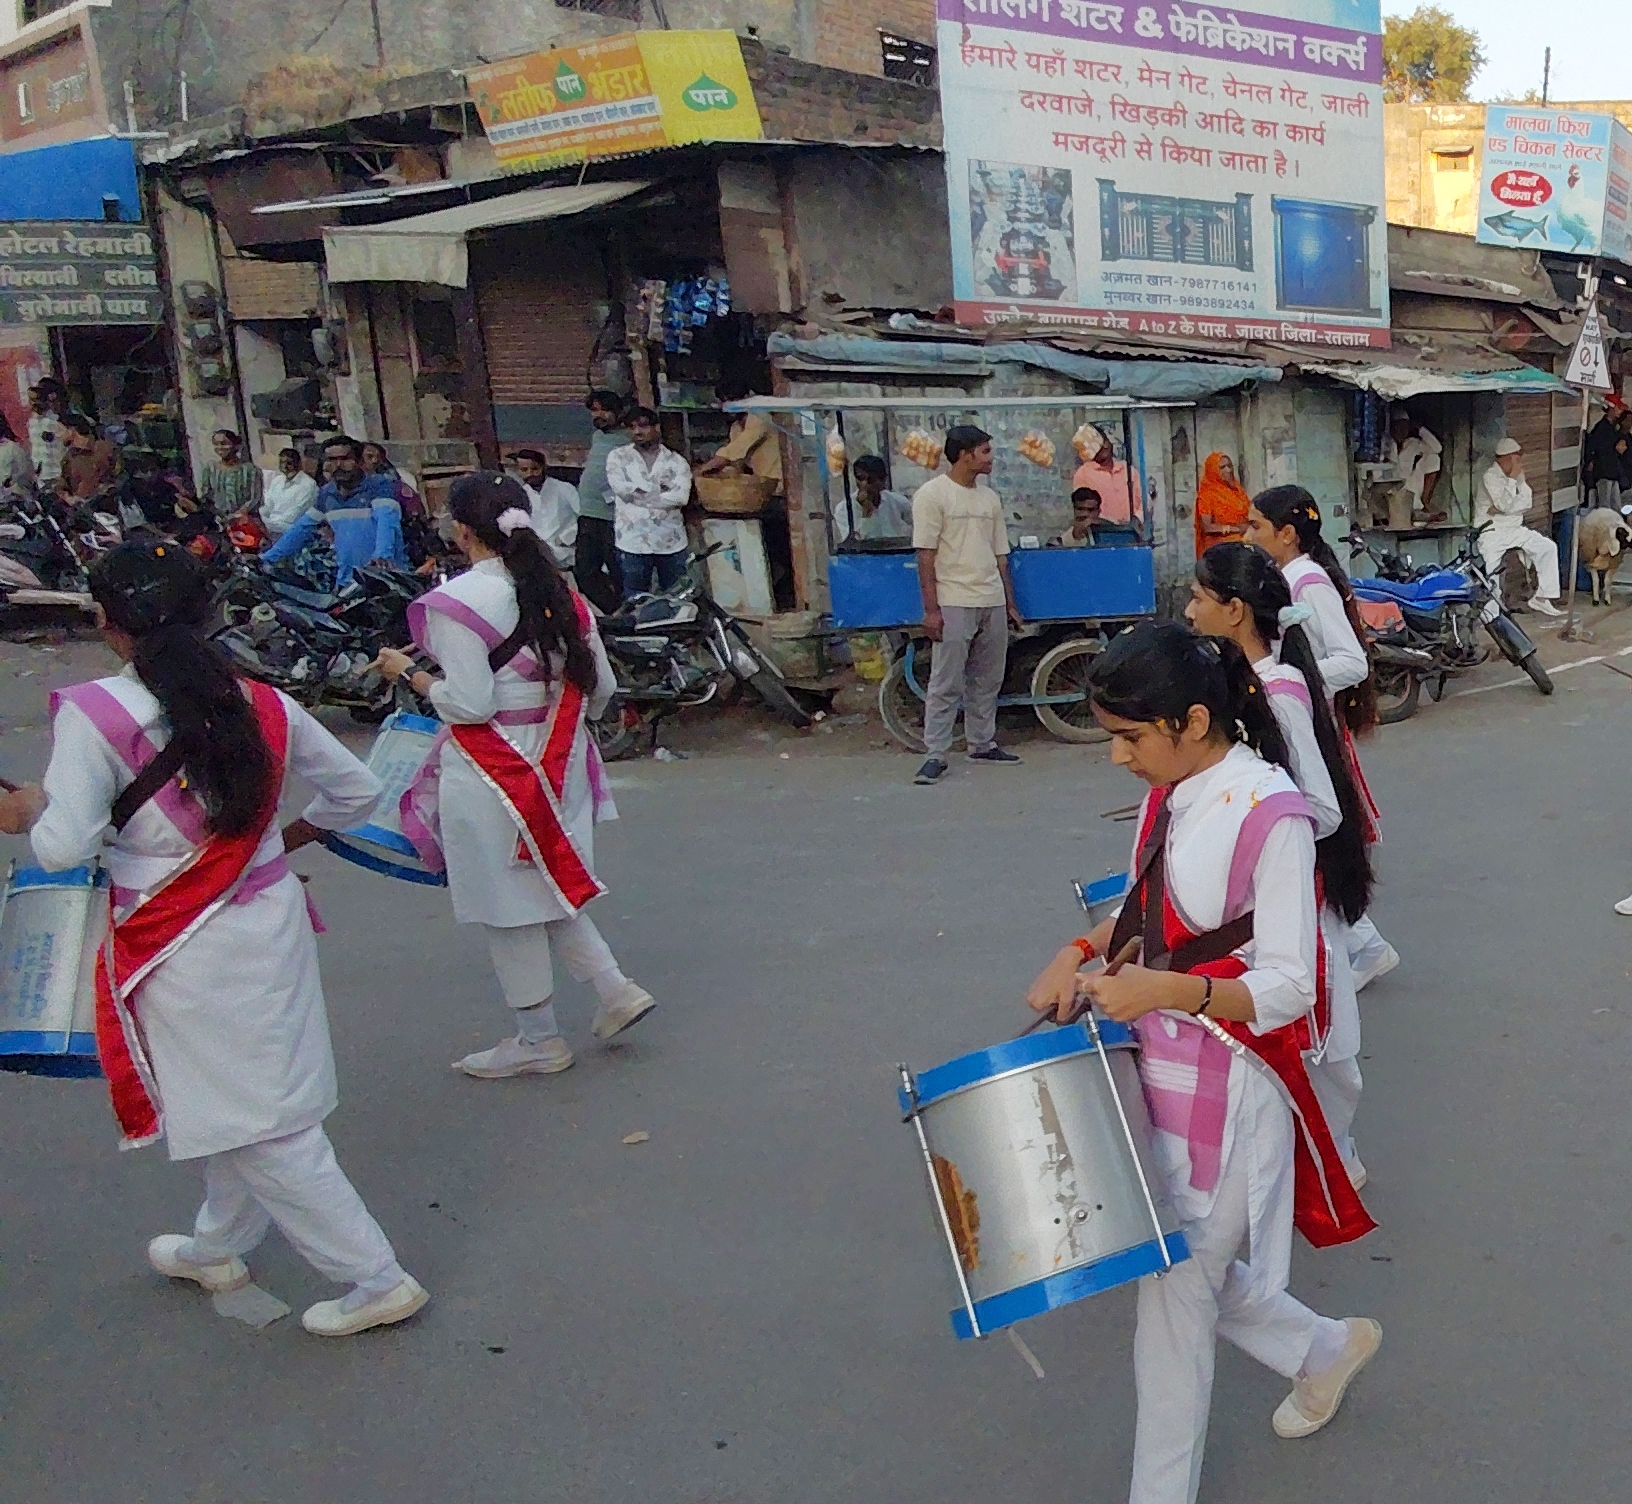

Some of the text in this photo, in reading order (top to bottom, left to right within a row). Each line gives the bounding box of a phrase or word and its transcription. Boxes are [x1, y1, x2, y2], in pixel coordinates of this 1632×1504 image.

[1134, 7, 1164, 40] &
[1169, 10, 1296, 61] फेब्रिकेशन
[1303, 35, 1367, 72] वर्क्स
[555, 73, 582, 94] पान
[588, 62, 649, 101] भंडार
[689, 89, 728, 106] पान
[959, 38, 1370, 119] हमारे यहाँ शटर, मेन गेट, चेनल गेट, जाली
[1018, 88, 1327, 147] दरवाजे, खिड़की आदि का कार्य
[1506, 114, 1592, 137] मालवा फिश
[1052, 127, 1127, 163] मजदूरी
[1134, 132, 1153, 161] से
[1160, 136, 1213, 169] किया
[1219, 149, 1268, 174] जाता
[1488, 133, 1605, 162] एंड चिकन सेन्टर
[1139, 320, 1149, 333] A
[1152, 319, 1165, 334] to
[1167, 320, 1177, 335] Z
[1179, 316, 1196, 337] के
[1235, 325, 1277, 343] जावरा
